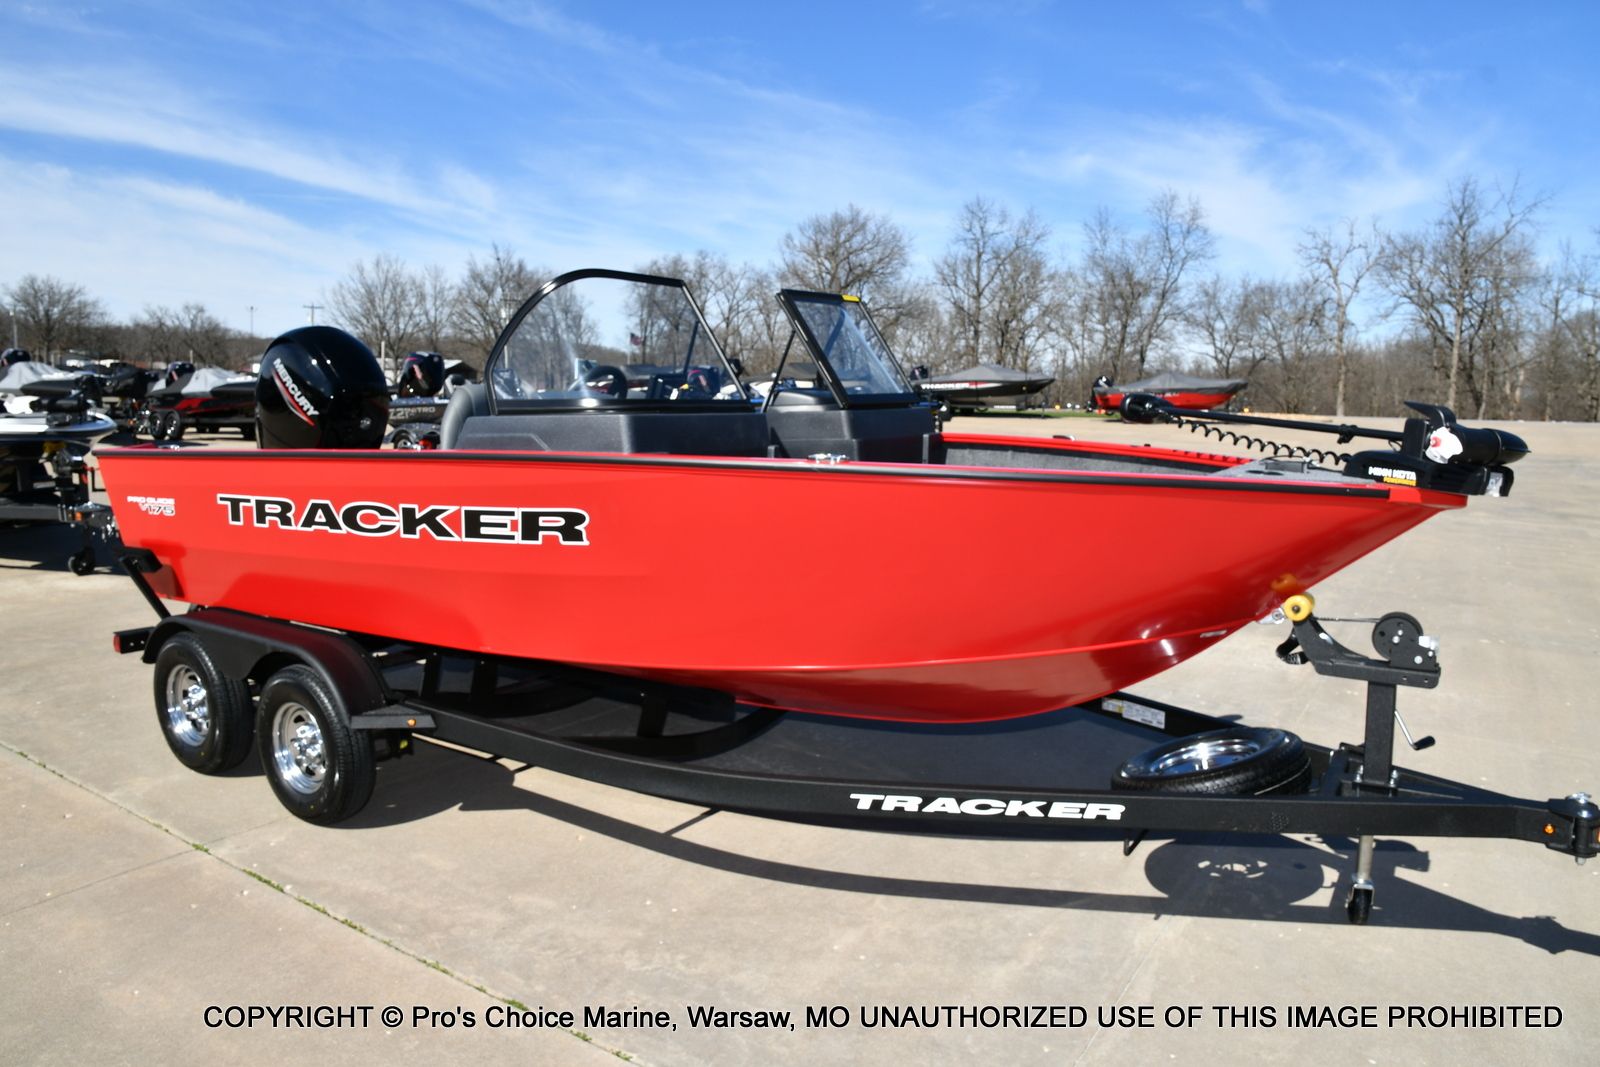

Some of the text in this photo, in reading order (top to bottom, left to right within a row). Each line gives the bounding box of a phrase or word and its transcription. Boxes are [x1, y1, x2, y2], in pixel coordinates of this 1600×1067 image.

[272, 357, 320, 416] MERCURY
[126, 495, 176, 505] PRO GUIDE
[216, 493, 590, 546] TRACKER
[849, 792, 1126, 821] TRACKER
